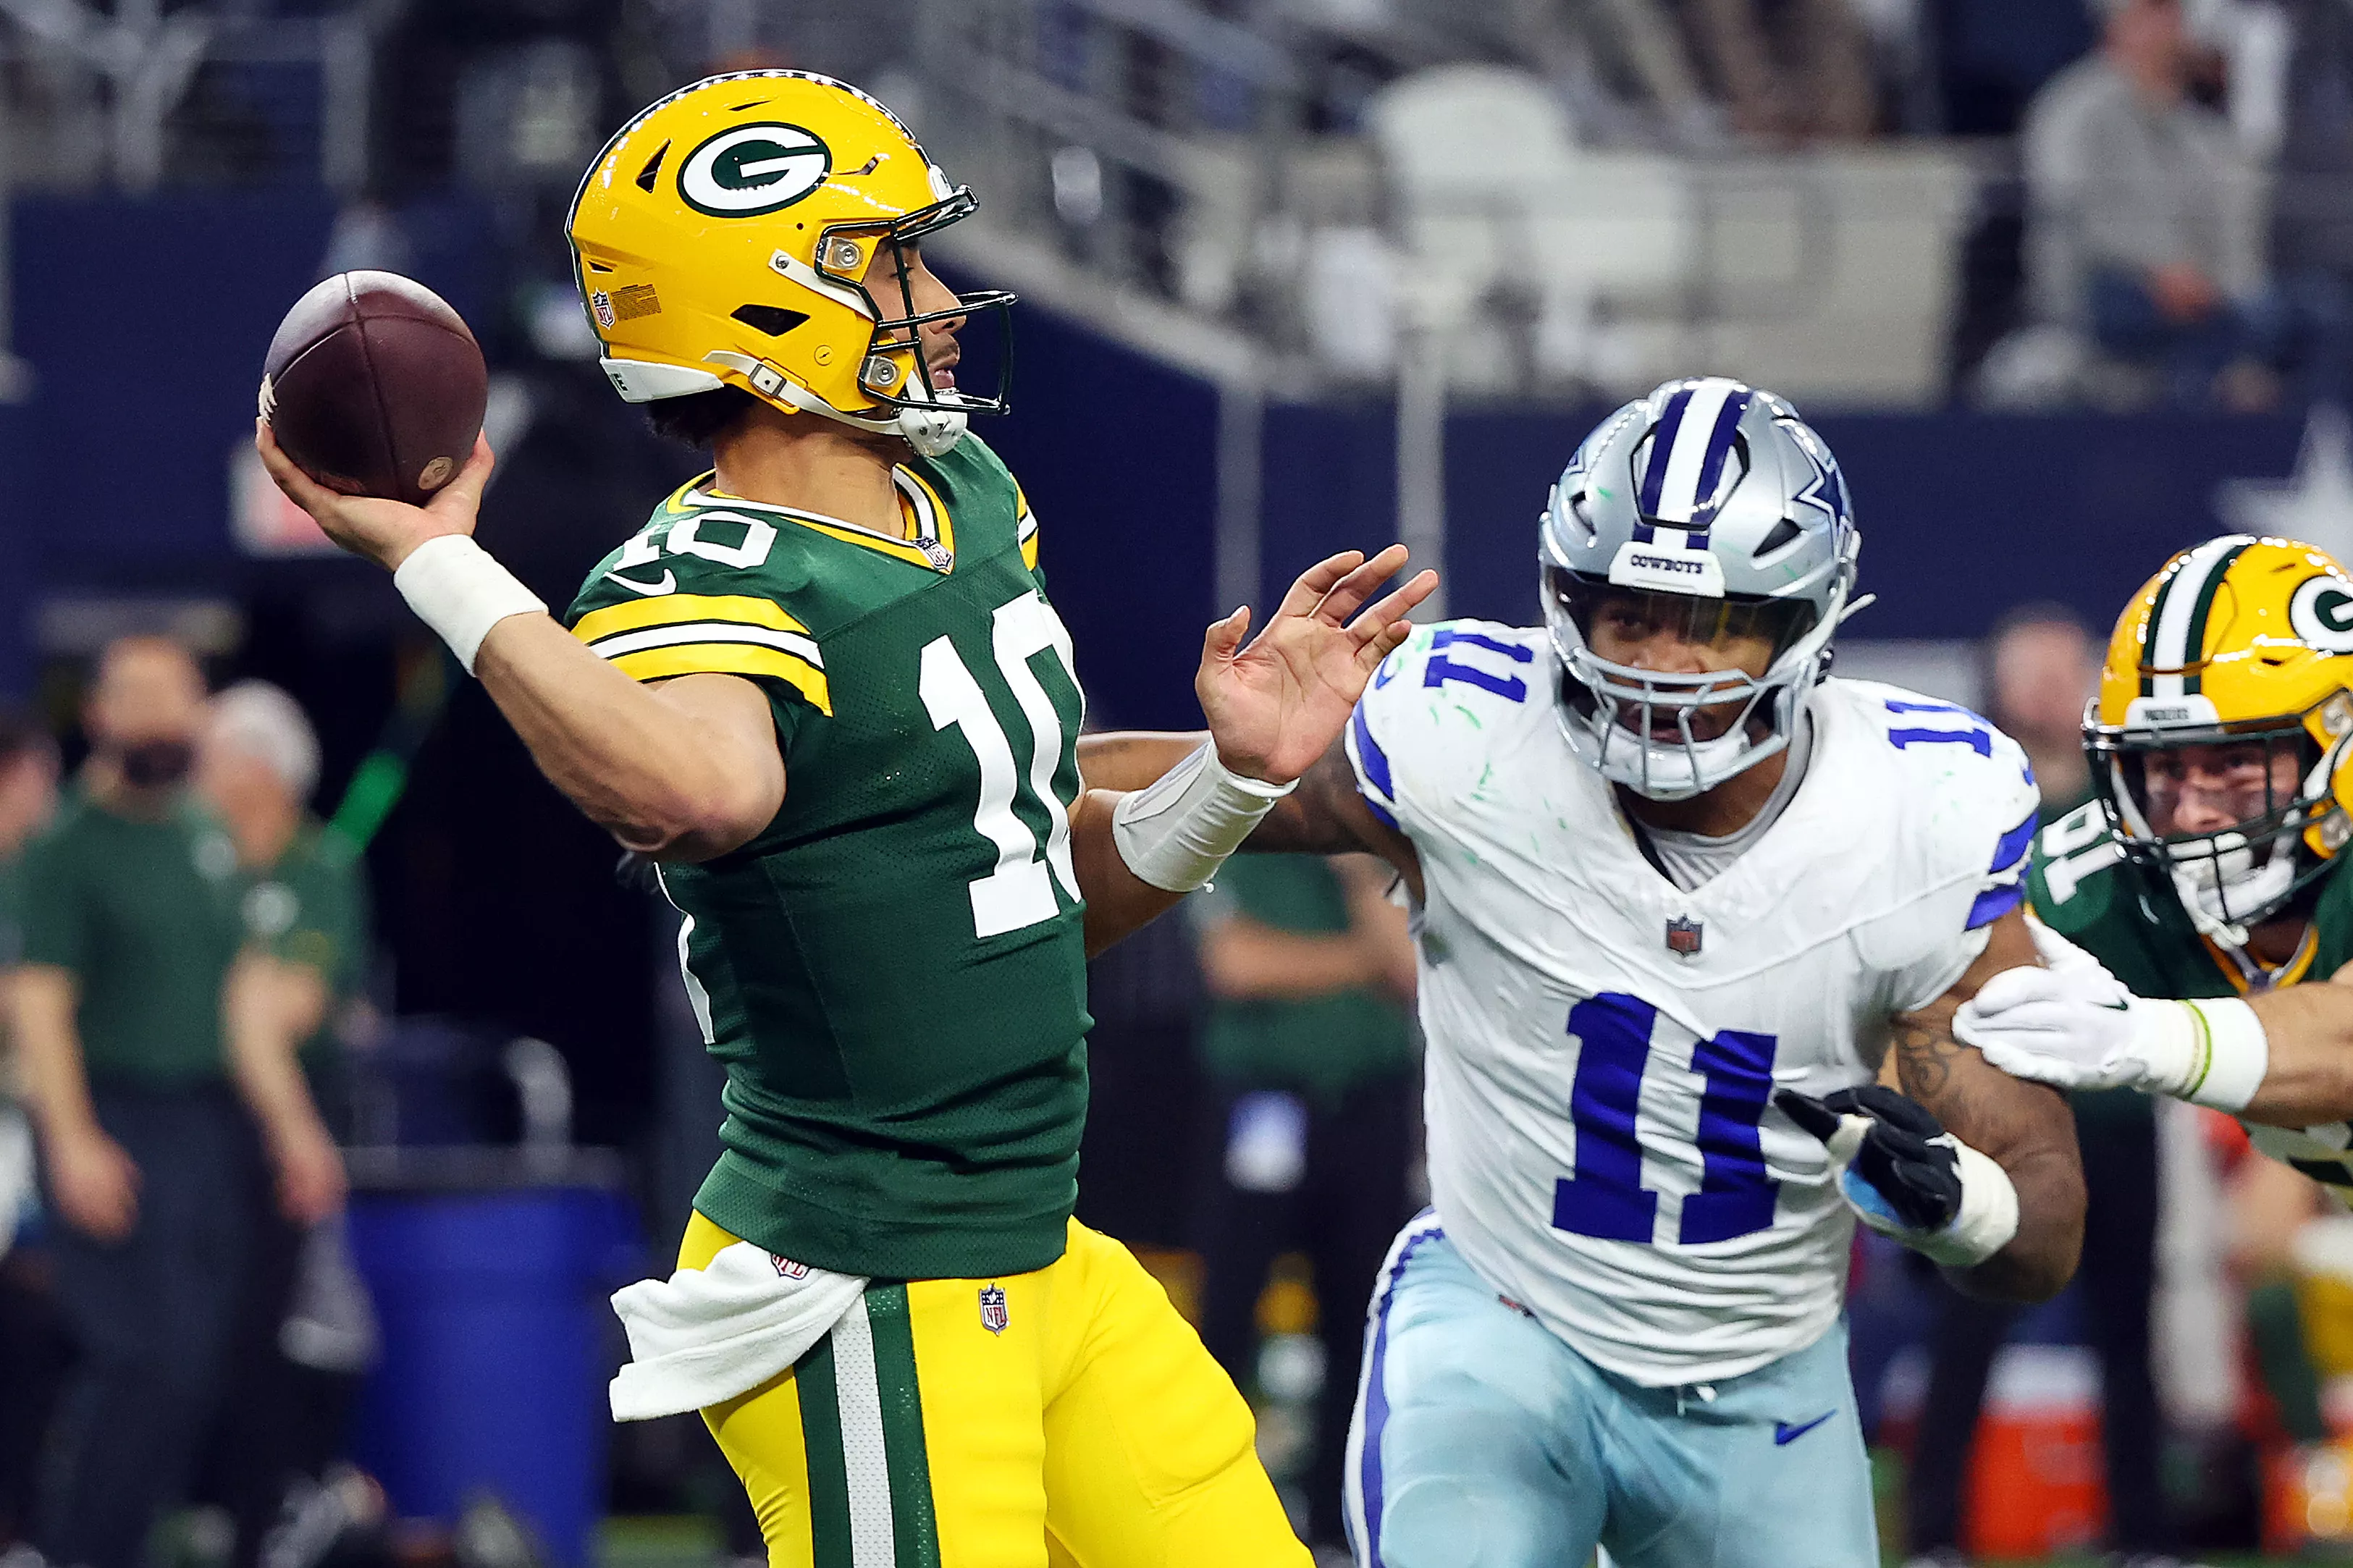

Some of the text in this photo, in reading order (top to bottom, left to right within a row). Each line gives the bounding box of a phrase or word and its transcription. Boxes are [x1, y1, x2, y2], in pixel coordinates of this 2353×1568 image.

[681, 125, 828, 211] G
[613, 511, 778, 570] 10
[1424, 630, 1533, 704] 11
[918, 588, 1086, 938] 10
[1885, 699, 1992, 758] 11
[1552, 992, 1778, 1244] 11
[985, 1306, 1007, 1325] NFL
